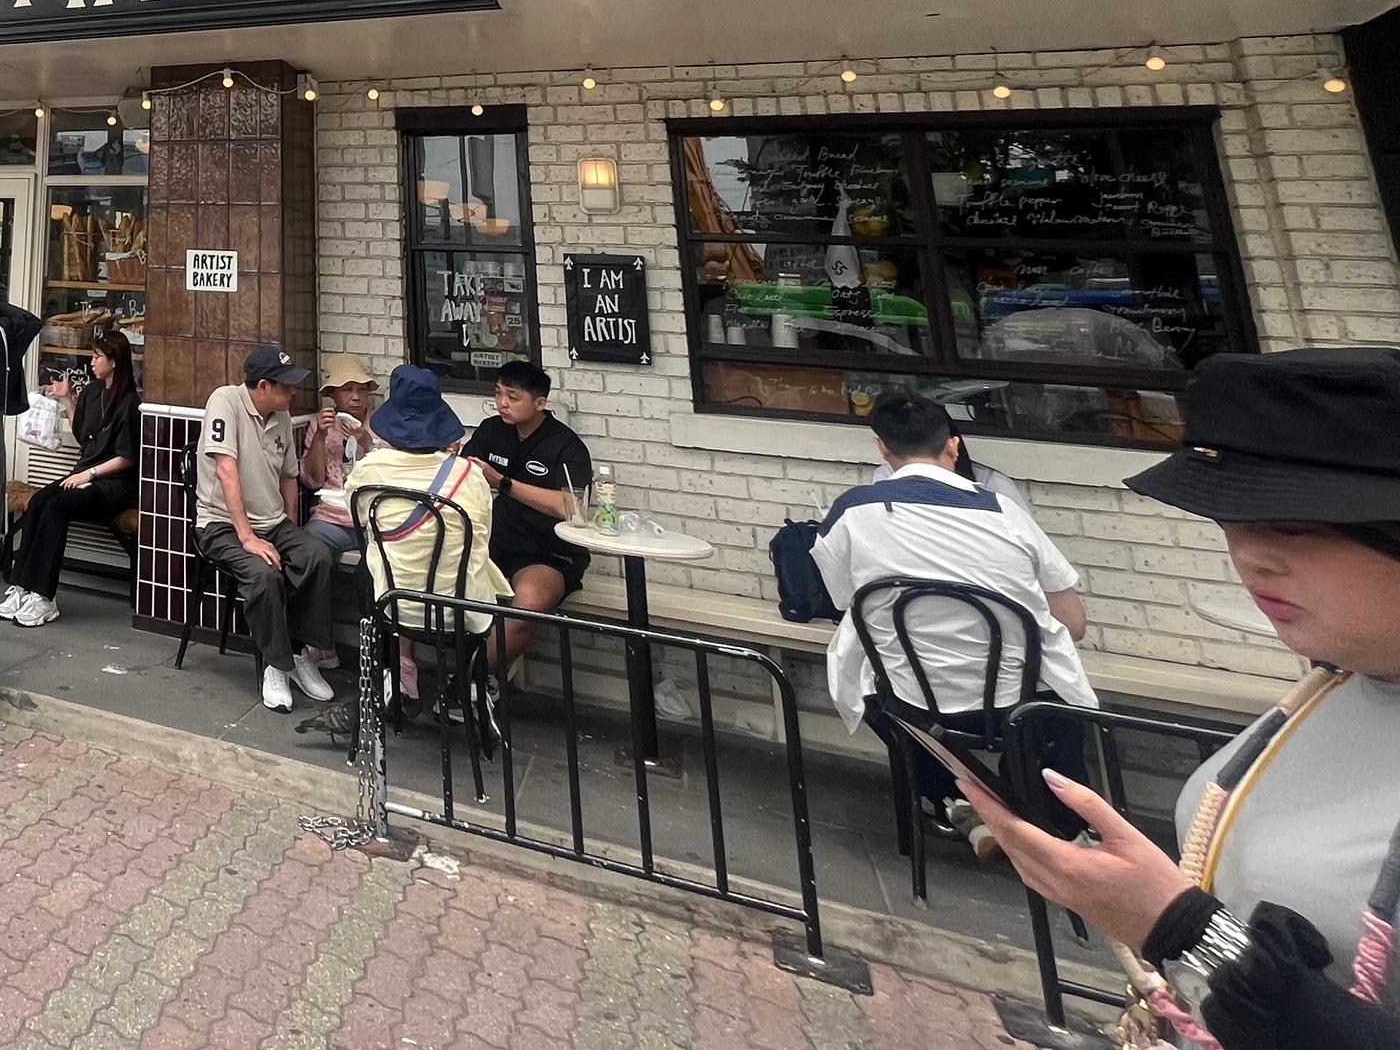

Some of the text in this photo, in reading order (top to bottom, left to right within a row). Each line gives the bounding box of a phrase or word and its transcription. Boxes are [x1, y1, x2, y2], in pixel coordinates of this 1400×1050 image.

[193, 254, 234, 271] ARTIST
[192, 271, 233, 288] BAKERY
[437, 270, 485, 297] TAKE
[582, 268, 624, 291] I AM
[440, 298, 484, 323] AWAY
[594, 293, 620, 315] AN
[507, 316, 521, 325] 25
[583, 316, 637, 345] ARTIST
[211, 418, 226, 443] 9
